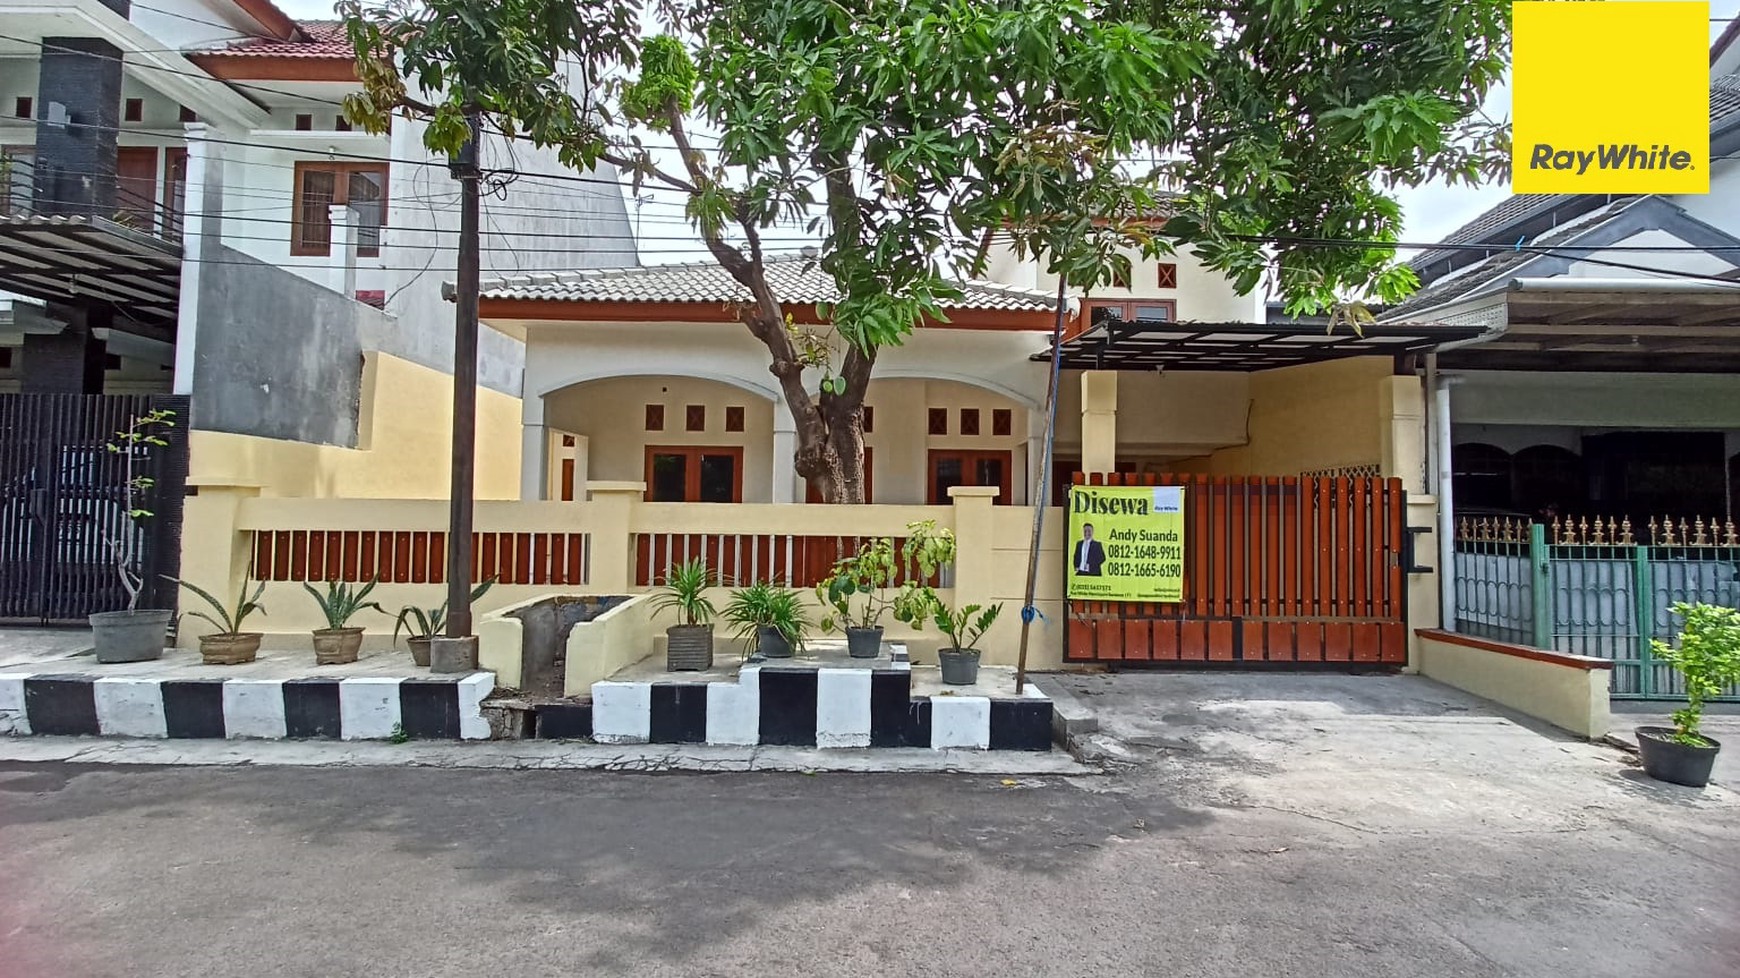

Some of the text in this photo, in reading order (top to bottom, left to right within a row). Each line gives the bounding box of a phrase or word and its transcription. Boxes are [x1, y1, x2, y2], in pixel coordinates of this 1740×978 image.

[1074, 490, 1149, 516] Disewa
[1109, 528, 1178, 542] Andy Suanda
[1108, 544, 1181, 560] 0812-1648-9911
[1107, 562, 1181, 577] 0812-1665-6190
